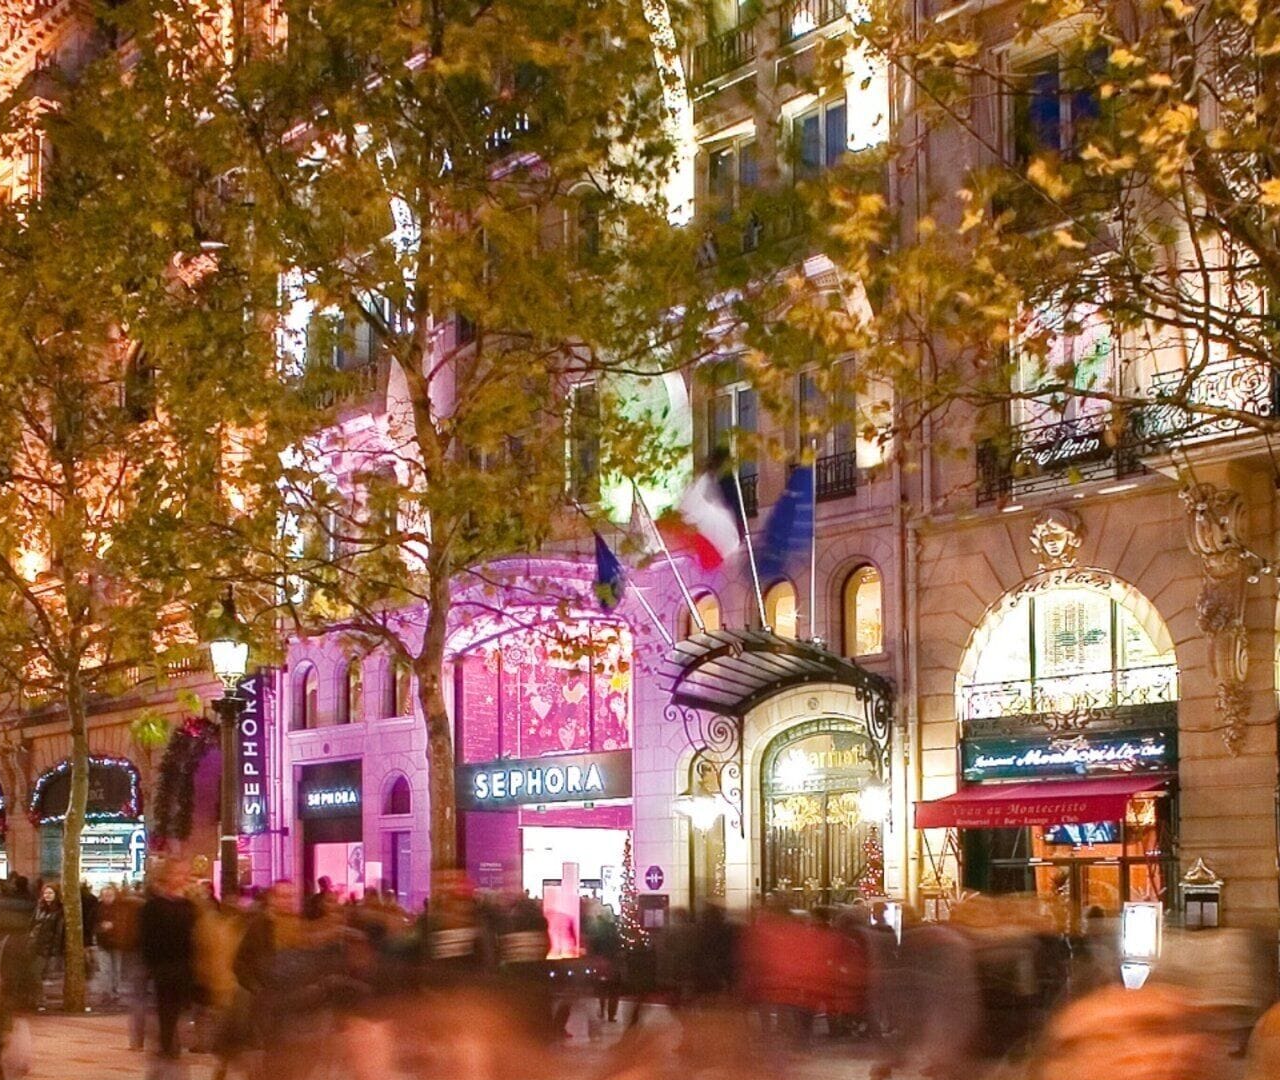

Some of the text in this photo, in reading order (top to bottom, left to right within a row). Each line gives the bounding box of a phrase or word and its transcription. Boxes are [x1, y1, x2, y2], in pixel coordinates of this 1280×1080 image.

[240, 678, 261, 815] SEPHORA
[308, 790, 357, 807] SEPHORA
[474, 763, 605, 799] SEPHORA
